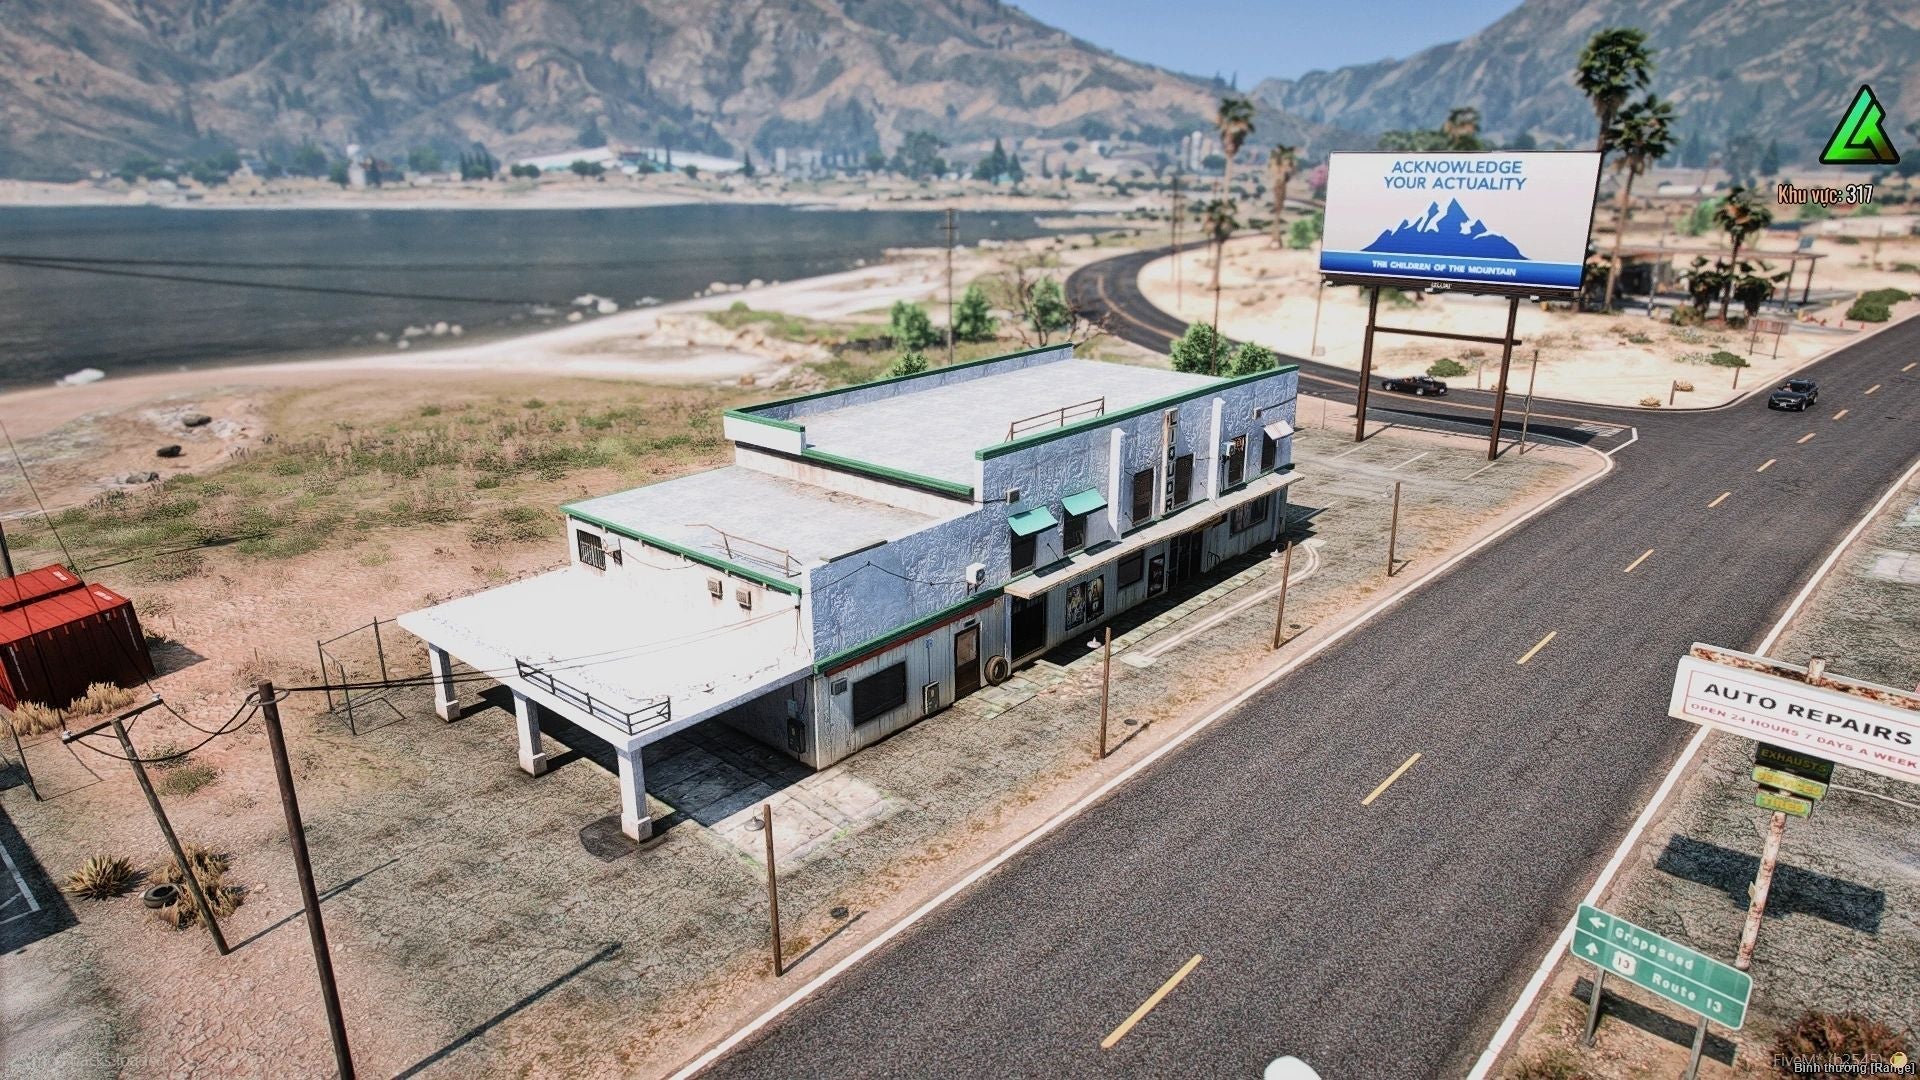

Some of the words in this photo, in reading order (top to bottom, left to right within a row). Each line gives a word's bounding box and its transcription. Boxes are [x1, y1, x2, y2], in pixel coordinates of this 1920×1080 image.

[1384, 176, 1427, 190] YOUR
[1432, 177, 1527, 191] ACTUALITY
[1391, 160, 1523, 174] ACKNOWLEDGE
[1372, 260, 1388, 268] THE
[1390, 261, 1430, 271] CHILDREN
[1449, 264, 1465, 273] THE
[1468, 266, 1517, 277] MOUNTAIN
[1704, 683, 1777, 710] AUTO
[1787, 703, 1913, 746] REPAIRS
[1690, 702, 1727, 718] OPEN
[1731, 713, 1746, 723] 24
[1751, 717, 1799, 737] HOURS
[1804, 730, 1812, 740] 7
[1816, 735, 1853, 752] DAYS
[1858, 747, 1869, 756] A
[1873, 751, 1919, 770] WEEK
[1760, 748, 1828, 773] EXHAUSTS
[1615, 927, 1694, 970] Grapeseed
[1653, 972, 1696, 1001] Route
[1706, 998, 1723, 1013] 13
